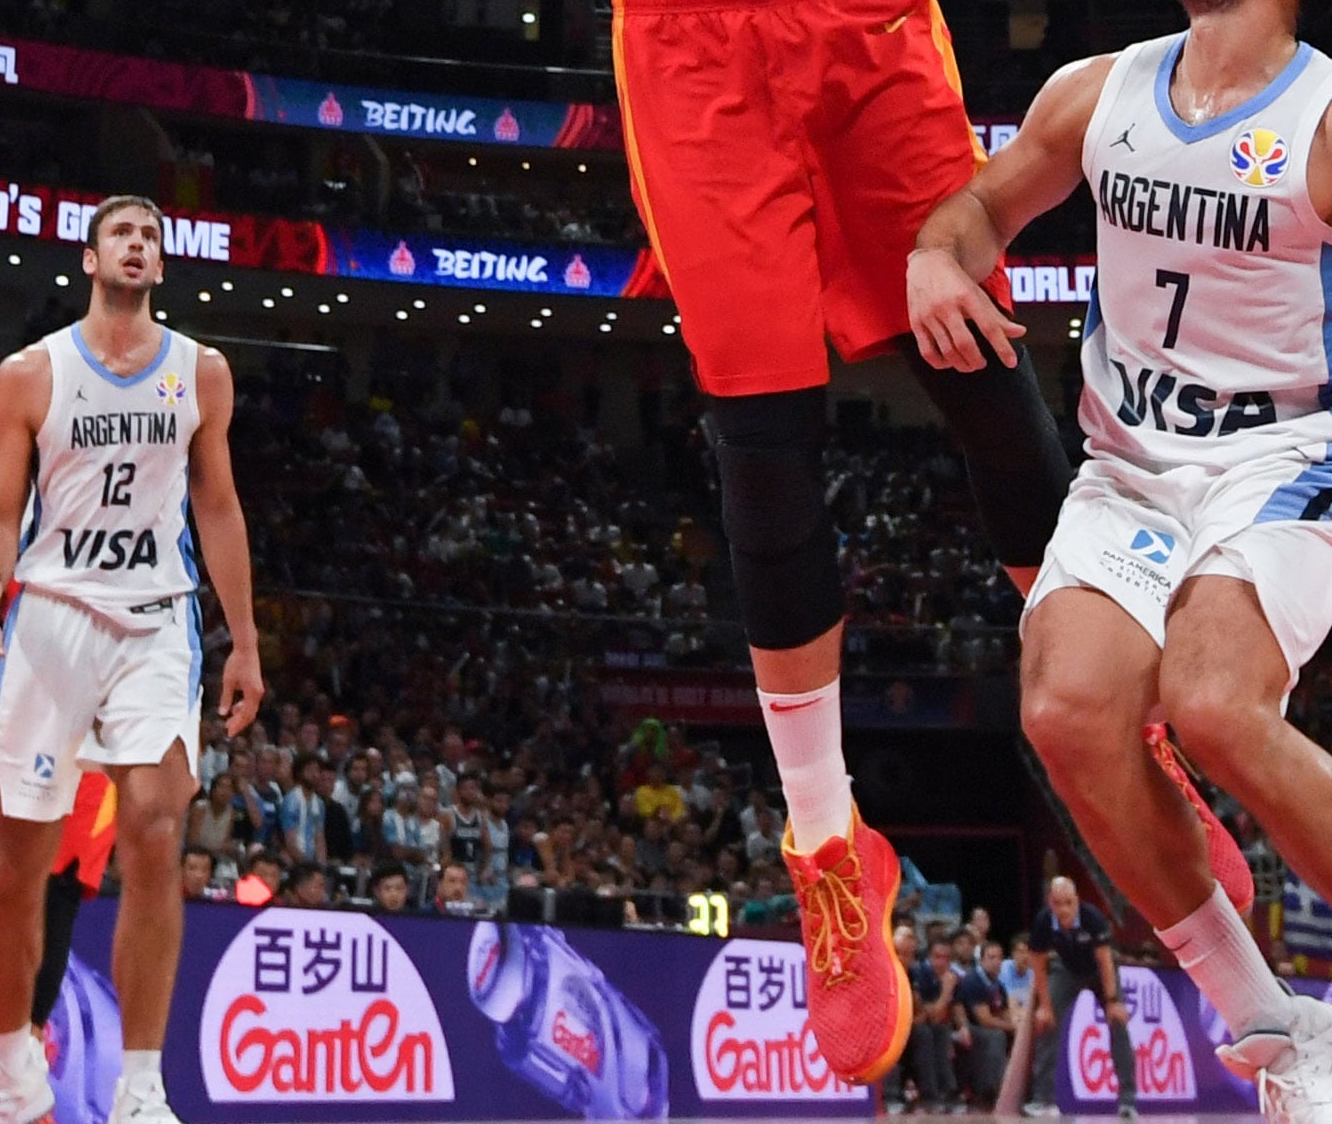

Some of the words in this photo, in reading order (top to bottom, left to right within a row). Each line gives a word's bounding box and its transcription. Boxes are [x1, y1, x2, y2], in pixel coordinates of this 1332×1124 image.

[1099, 169, 1270, 252] ARGENTINA
[1155, 269, 1190, 349] 7
[1111, 358, 1277, 439] VISA
[71, 413, 176, 449] ARGENTINA
[101, 463, 135, 507] 12
[61, 529, 158, 570] VISA
[1103, 550, 1125, 563] PAN
[253, 926, 388, 994] 百岁山
